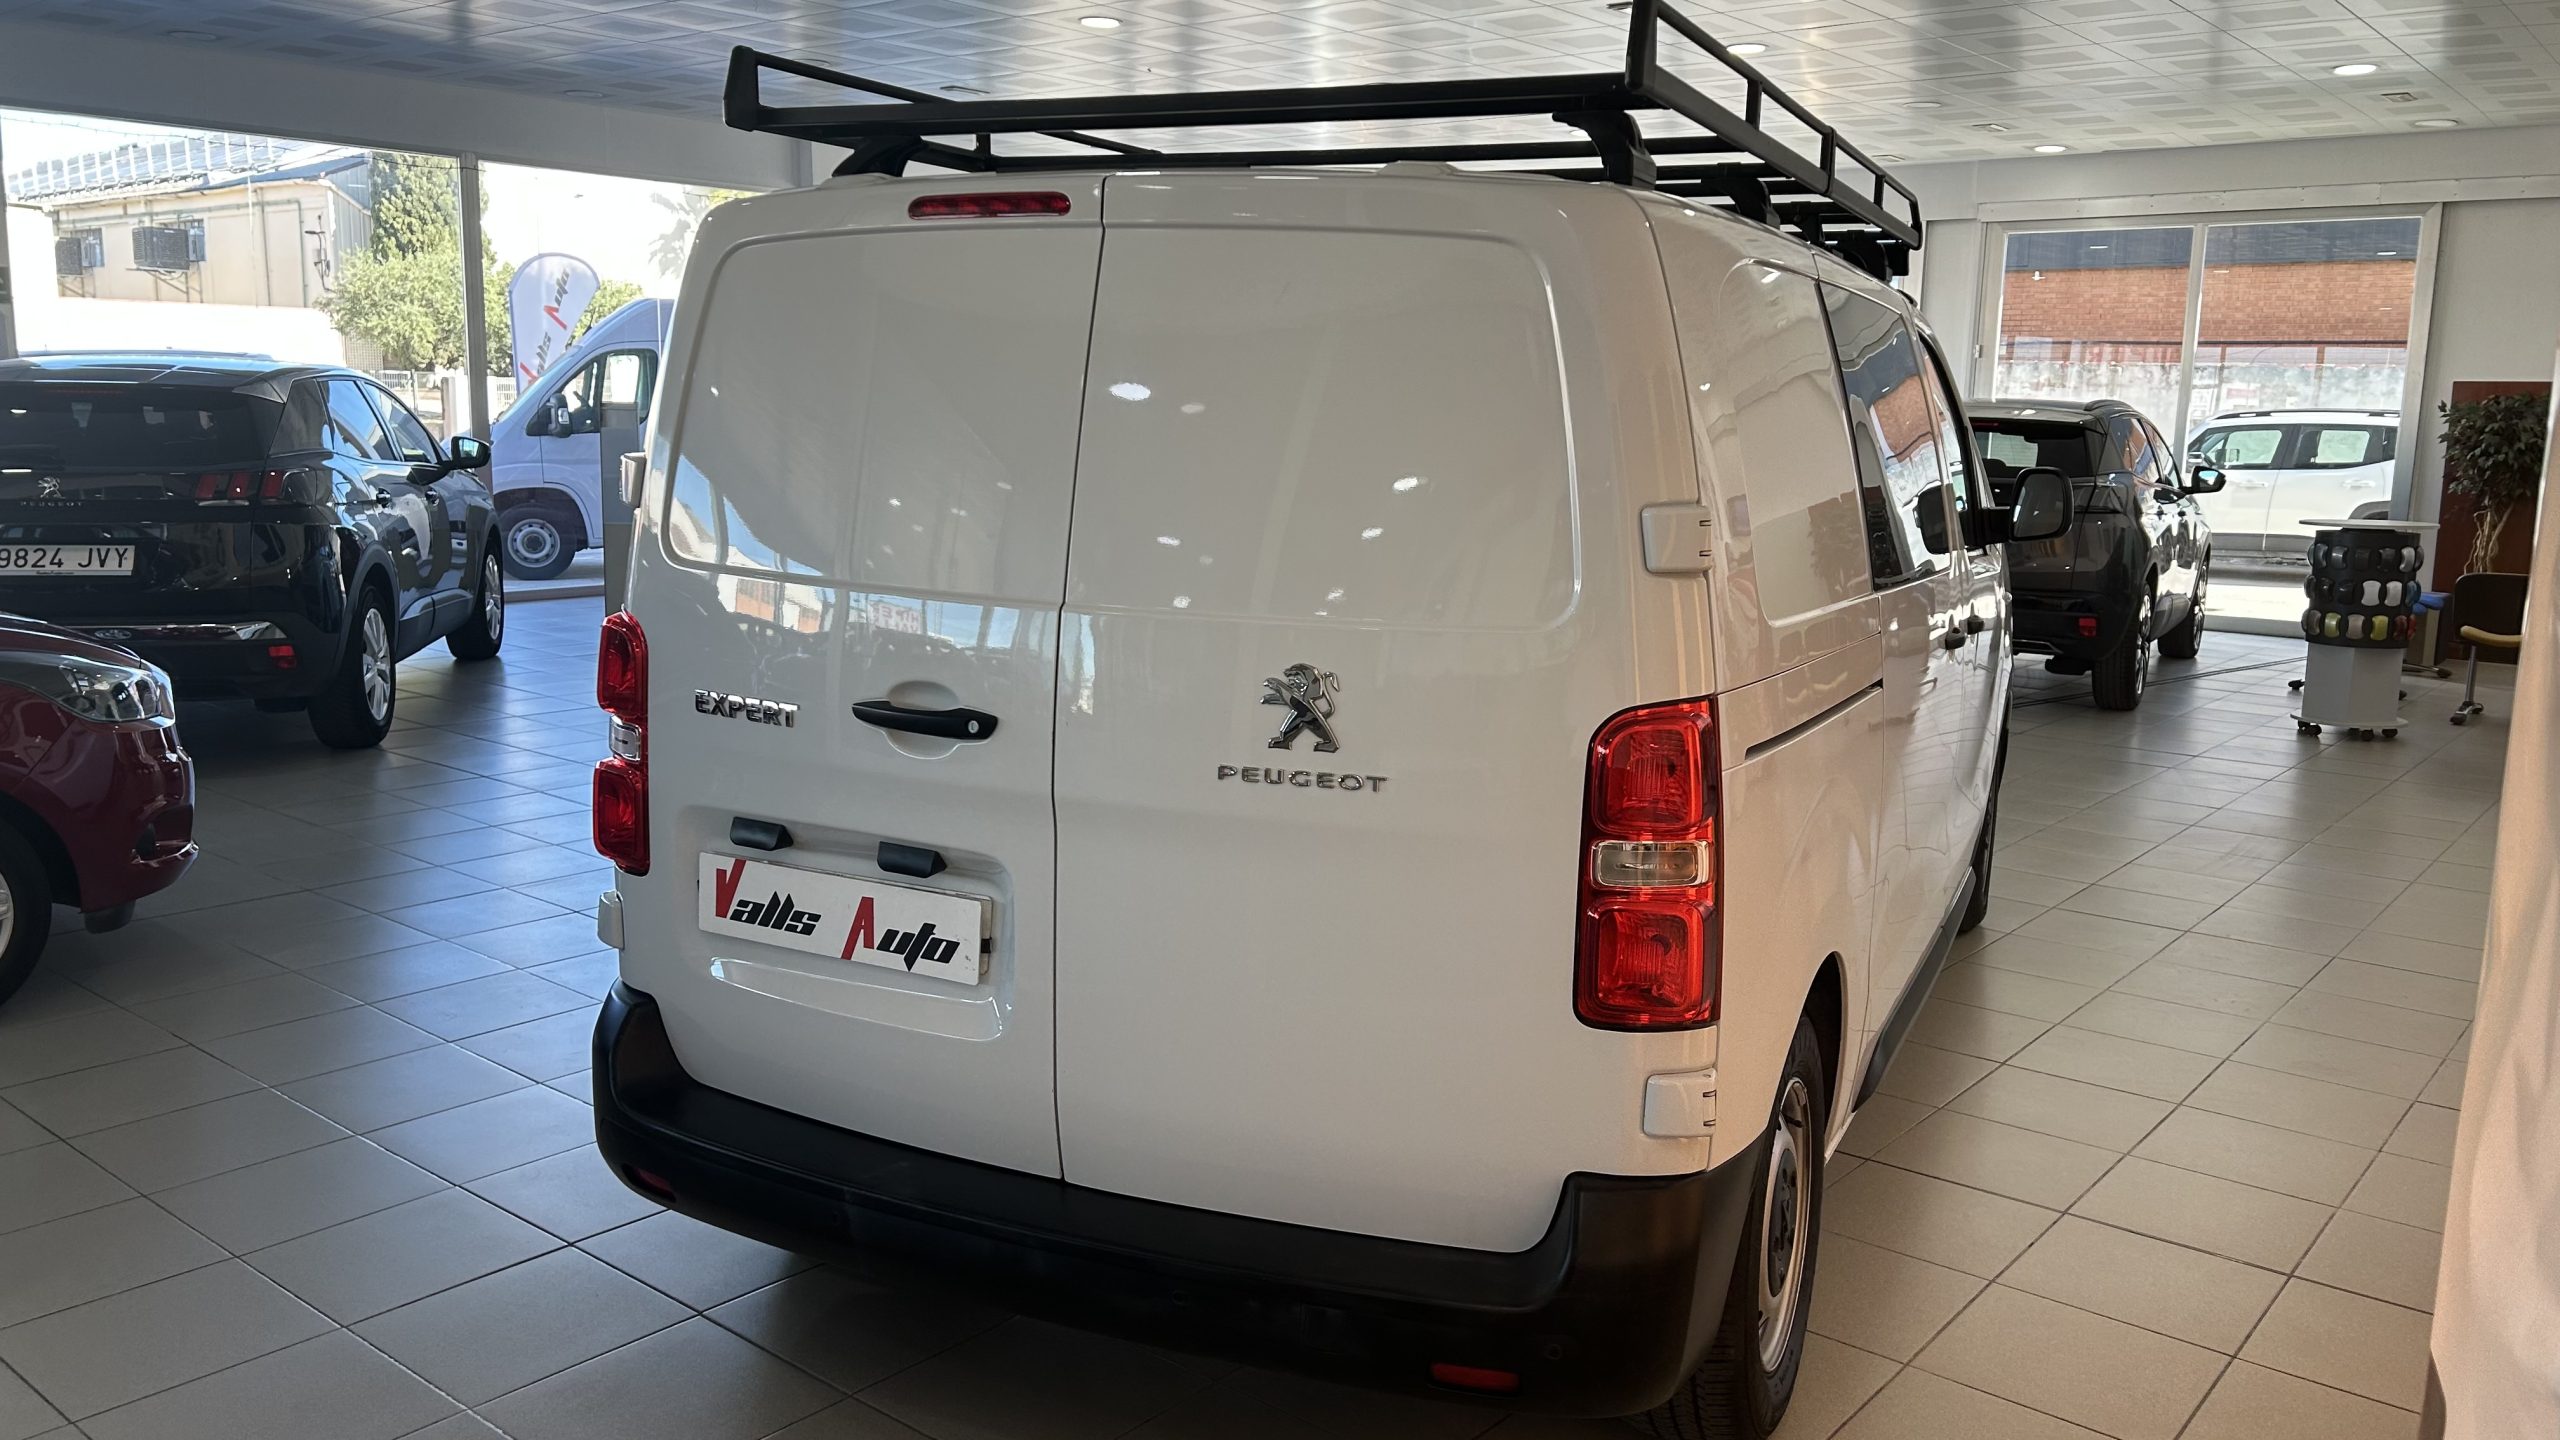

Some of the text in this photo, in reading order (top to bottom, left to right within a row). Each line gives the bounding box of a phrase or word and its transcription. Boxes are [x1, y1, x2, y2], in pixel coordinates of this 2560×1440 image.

[543, 268, 570, 331] Auto
[0, 547, 129, 569] 9824 JVY
[695, 689, 800, 728] EXPERT
[1217, 764, 1390, 793] PEUGEOT
[715, 858, 961, 973] Valls Auto
